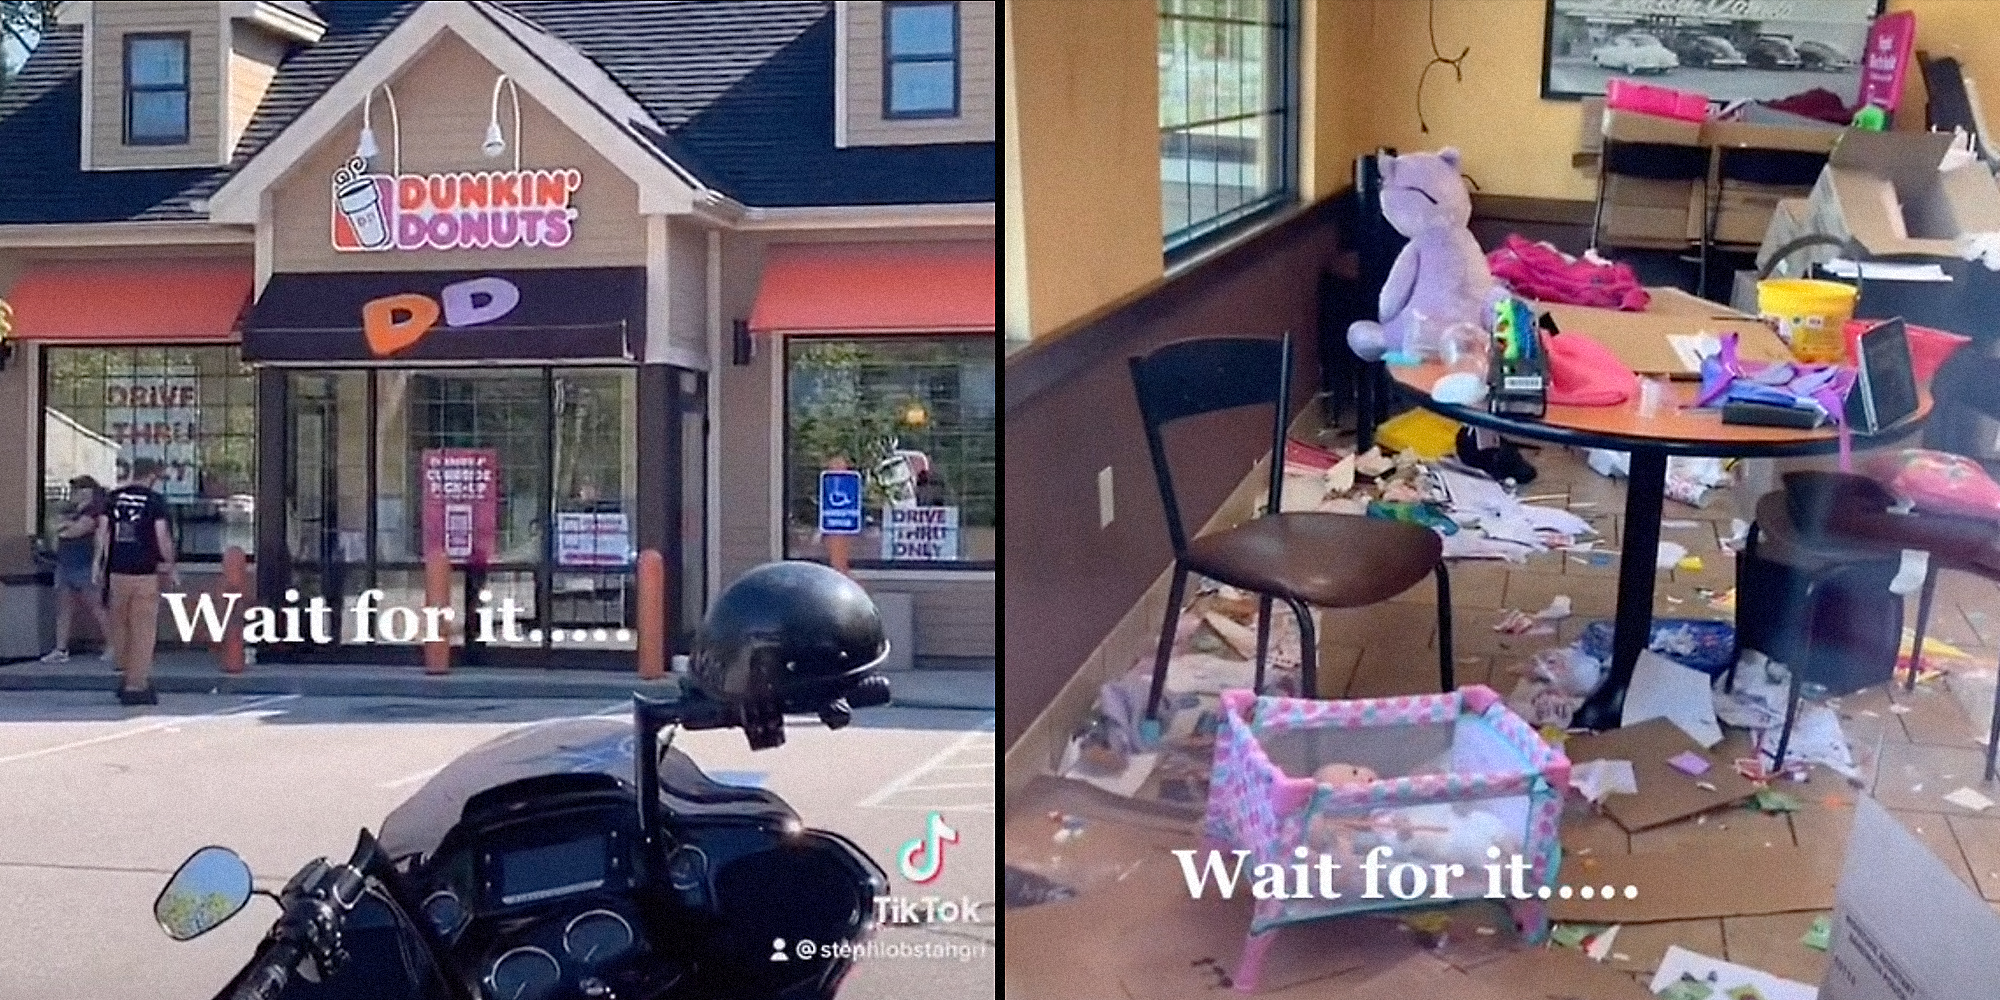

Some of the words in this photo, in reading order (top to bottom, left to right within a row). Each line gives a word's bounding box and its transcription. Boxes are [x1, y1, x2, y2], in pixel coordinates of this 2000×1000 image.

[399, 171, 581, 209] DUNKIN'
[399, 211, 573, 247] DONUTS
[108, 384, 194, 407] DRIVE
[891, 508, 946, 523] DRIVE
[893, 526, 947, 540] THRU
[892, 543, 943, 556] ONLY
